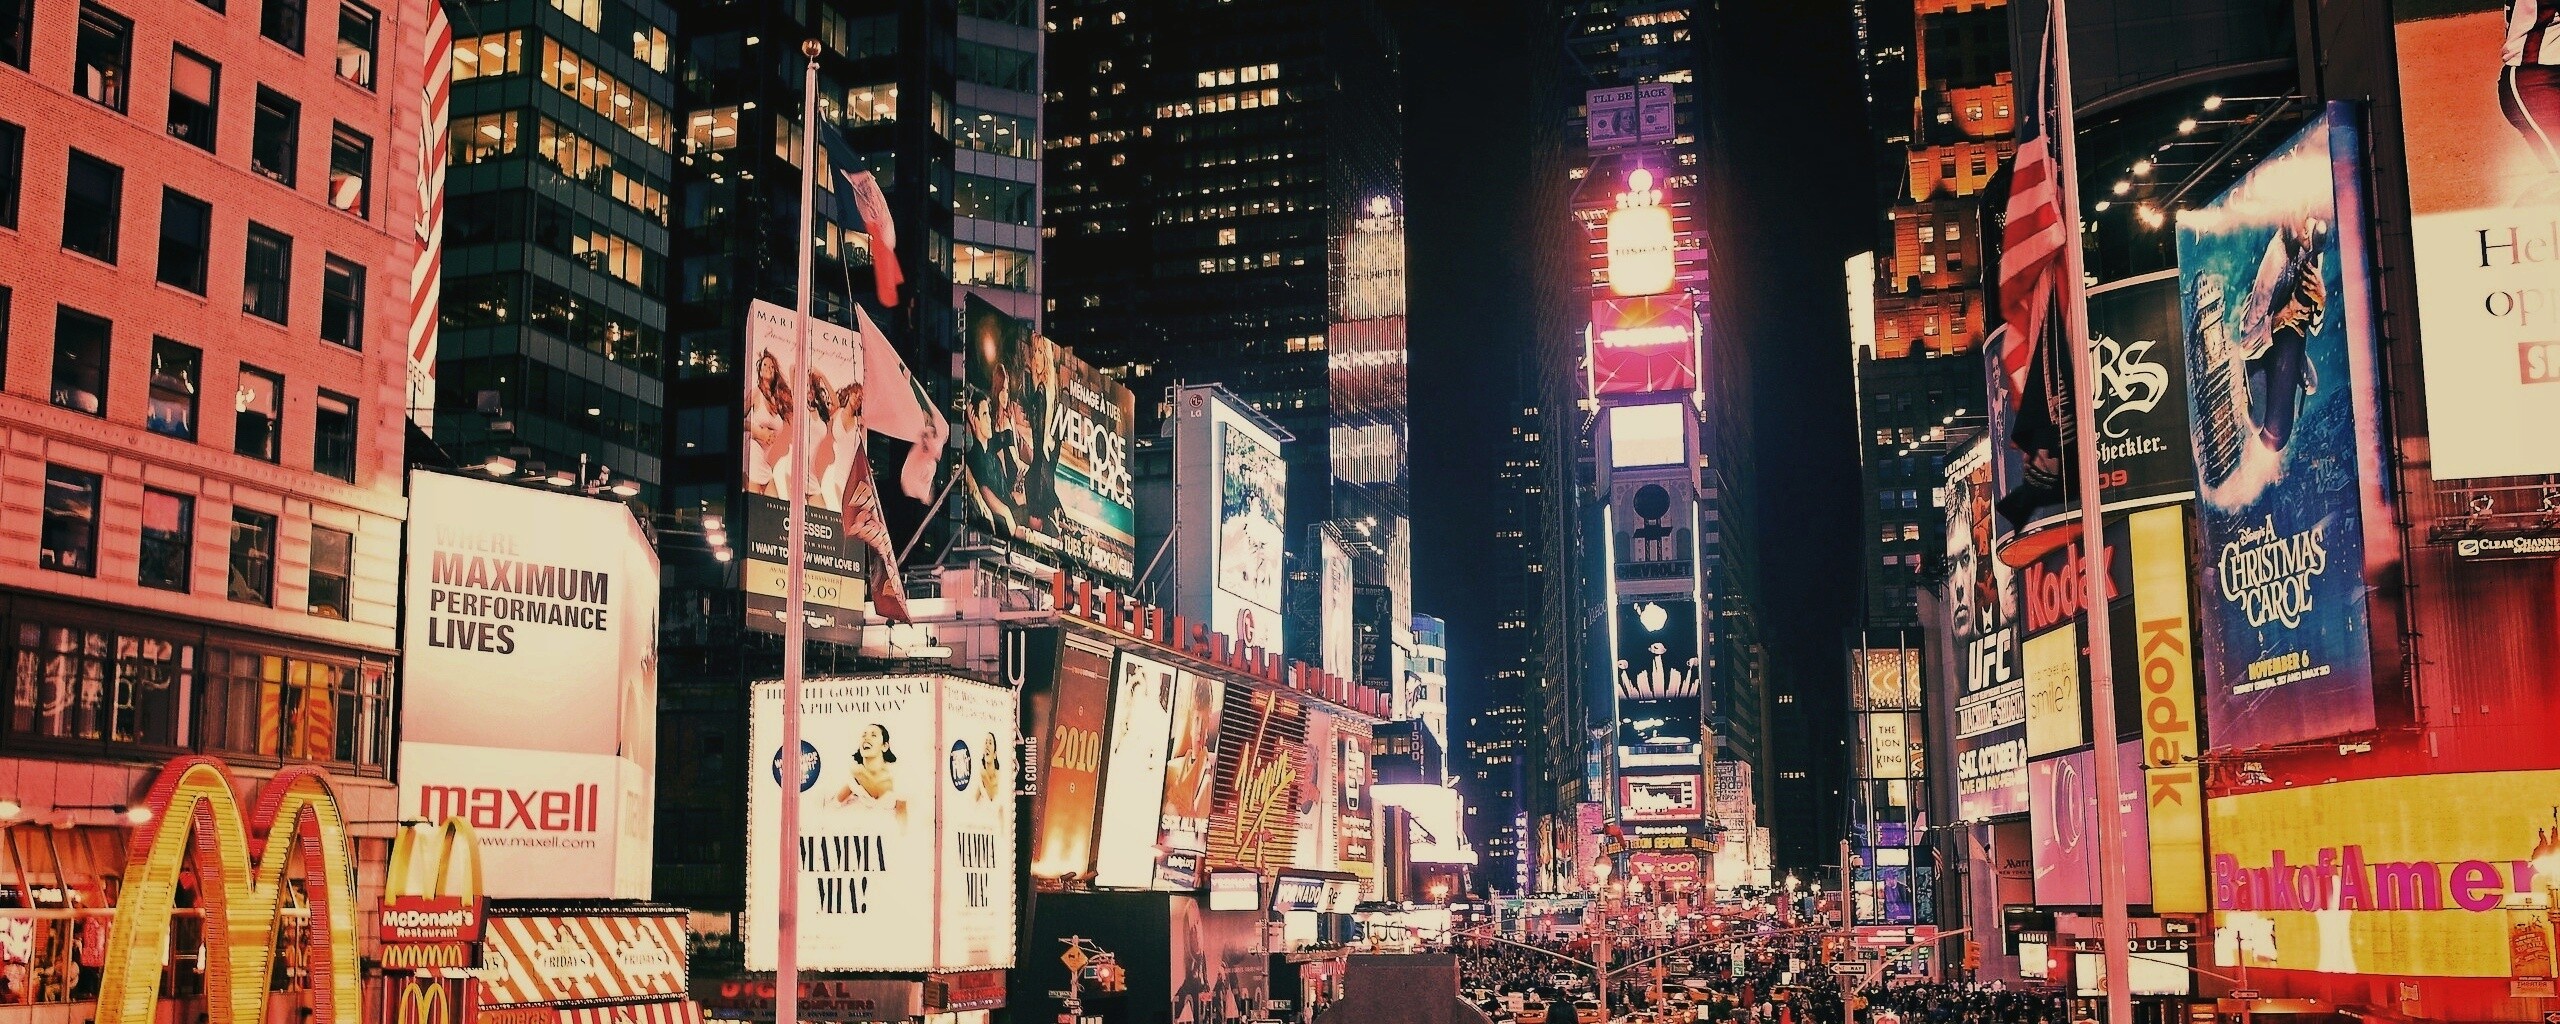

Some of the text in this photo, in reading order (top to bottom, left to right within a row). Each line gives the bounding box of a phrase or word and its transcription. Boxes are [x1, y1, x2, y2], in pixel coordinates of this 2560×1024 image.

[1617, 91, 1633, 101] BE
[756, 310, 795, 331] MARI
[1069, 377, 1100, 410] MÉNAGE
[1190, 410, 1202, 418] LG
[1049, 402, 1127, 468] MELROSE
[1088, 455, 1134, 510] PLACE
[434, 523, 521, 557] WHERE
[782, 515, 834, 541] OESSED
[2264, 513, 2278, 543] A
[756, 543, 778, 557] WANT
[813, 554, 834, 569] WHAT
[834, 557, 854, 573] LOVE
[431, 550, 609, 606] MAXIMUM
[2217, 528, 2327, 612] CHRISTMAS
[430, 588, 608, 631] PERFORMANCE
[2246, 568, 2314, 630] CAROL
[428, 616, 516, 655] LIVES
[1968, 627, 2013, 692] UFC
[2247, 649, 2310, 681] NOVEMBER 6
[1878, 725, 1896, 735] THE
[2141, 616, 2193, 809] Kodak
[1024, 736, 1038, 781] COMING
[1051, 723, 1100, 774] 2010
[1411, 721, 1420, 761] 1500
[1875, 738, 1900, 752] LION
[1979, 740, 2018, 776] OCTOBER
[1876, 754, 1902, 769] KING
[1024, 783, 1037, 796] IS
[420, 783, 598, 833] maxell
[477, 835, 596, 849] ww.maxell.com
[798, 835, 886, 872] MAMMA
[957, 831, 996, 868] MAMMA
[817, 875, 868, 914] MIA!
[965, 871, 989, 908] MIA!
[2215, 849, 2299, 911] Bank
[382, 909, 475, 928] McDonald's
[396, 926, 459, 939] Restaurant
[2074, 939, 2189, 952] MAQUIS
